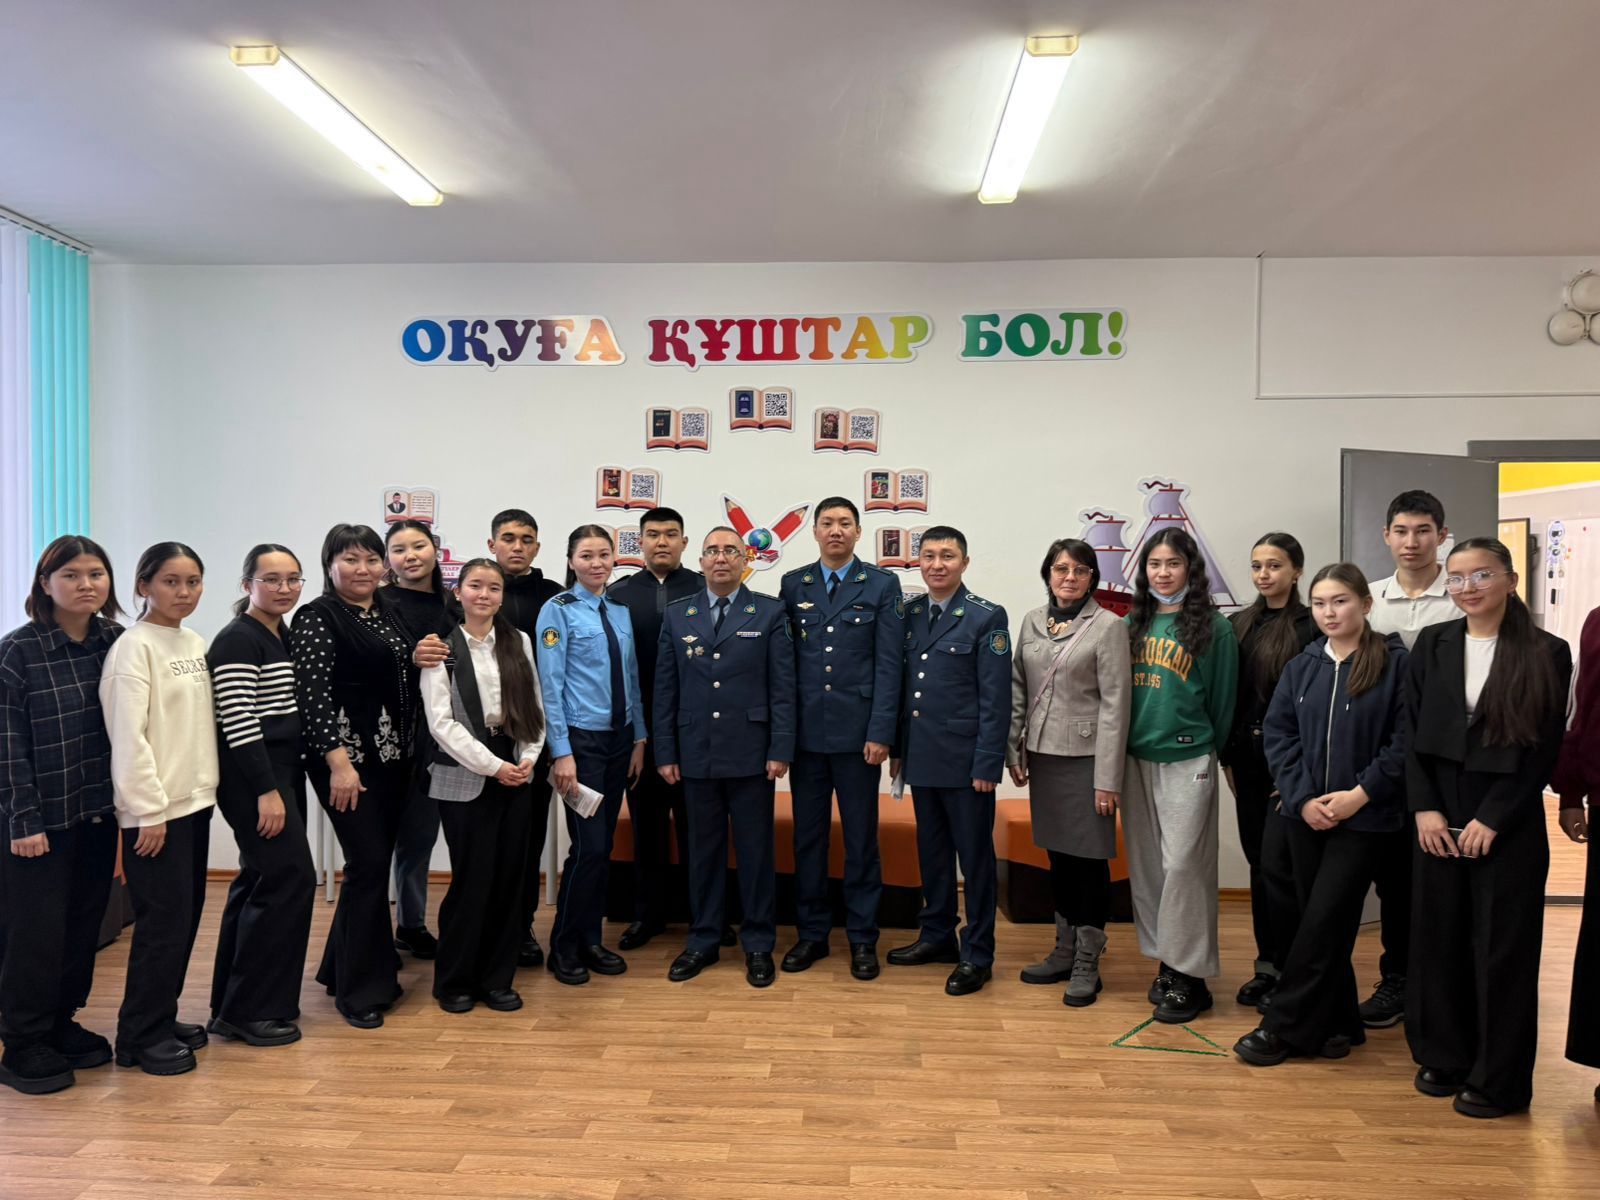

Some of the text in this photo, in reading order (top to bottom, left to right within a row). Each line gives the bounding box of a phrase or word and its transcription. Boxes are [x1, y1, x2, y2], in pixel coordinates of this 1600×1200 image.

[402, 311, 1123, 367] ОҚУҒА ҚҰШТАР БОЛ!
